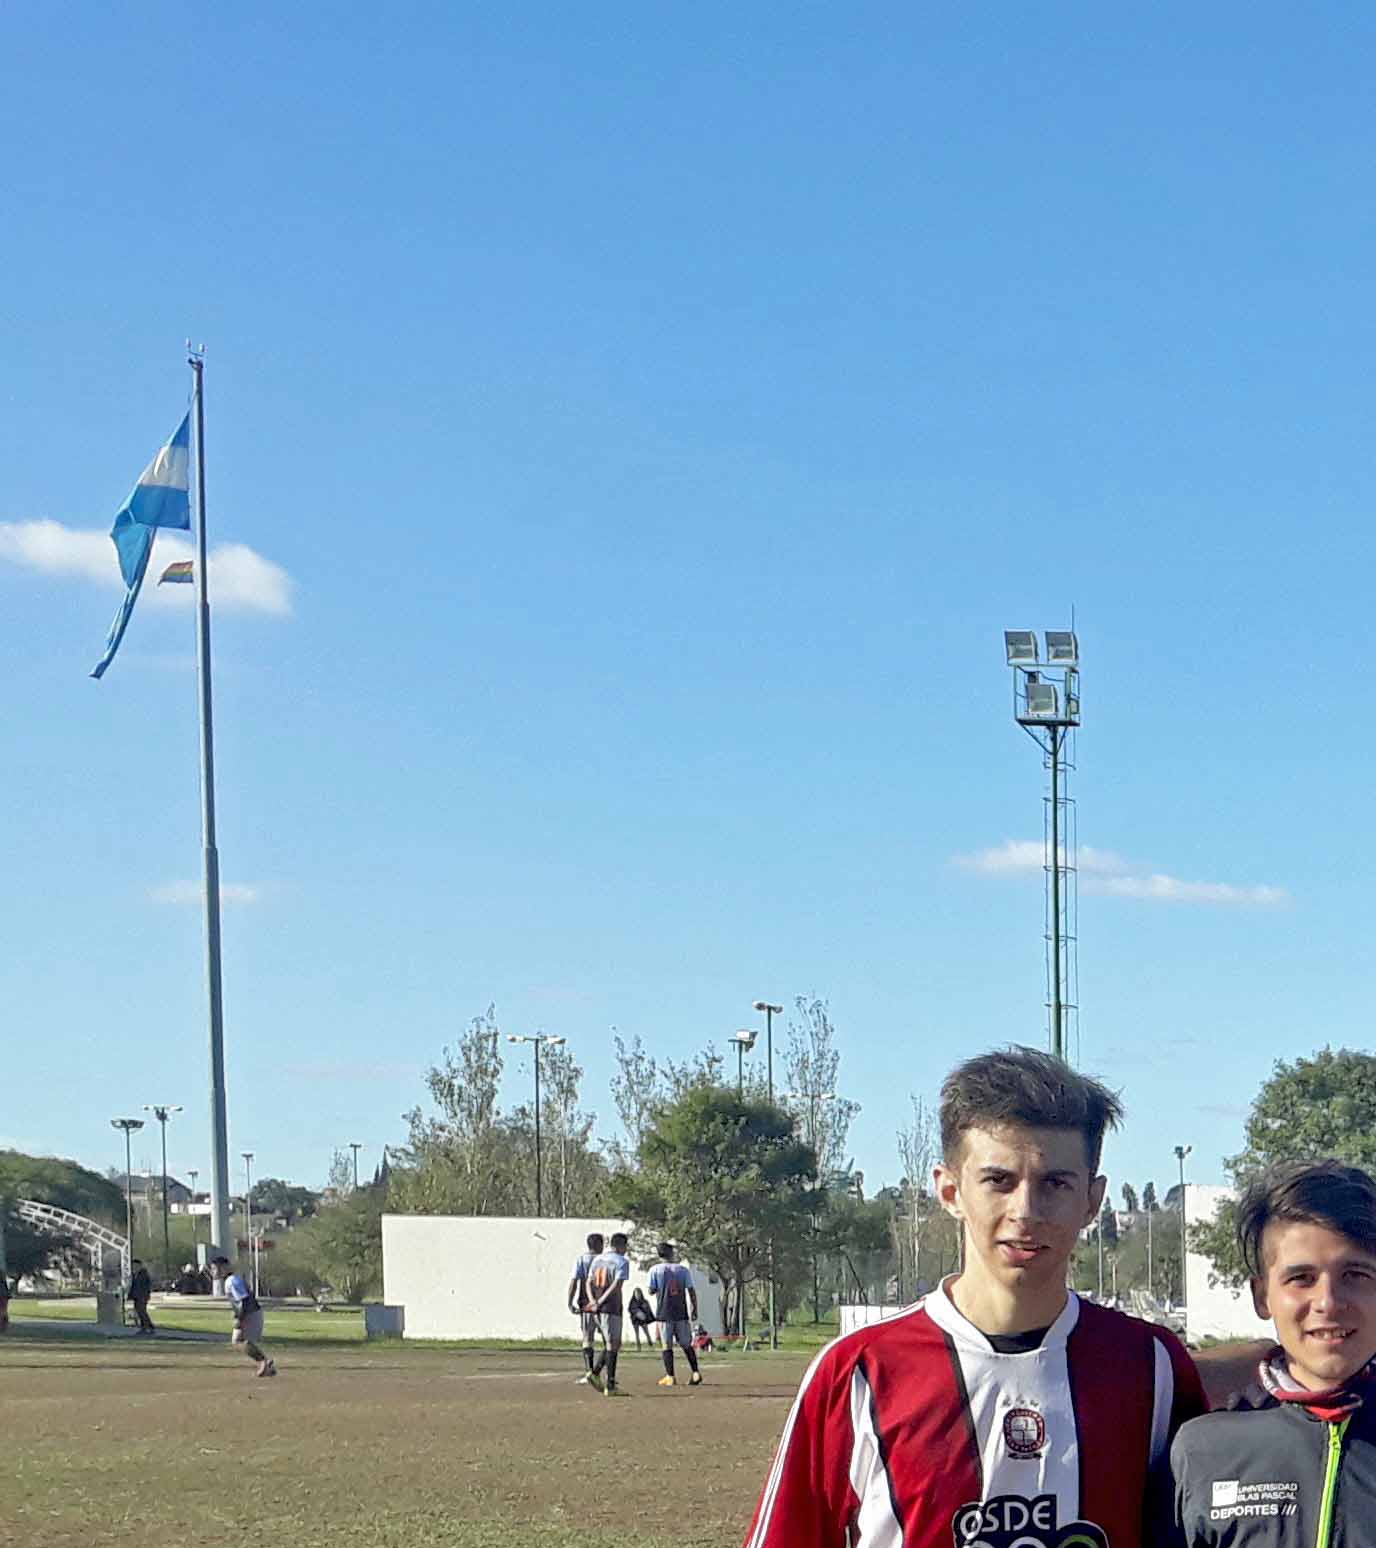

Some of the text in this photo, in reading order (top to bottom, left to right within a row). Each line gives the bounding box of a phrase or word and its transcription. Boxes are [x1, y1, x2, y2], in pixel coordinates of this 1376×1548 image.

[1239, 1483, 1298, 1493] UNIVERSIDAD
[1238, 1492, 1297, 1502] BLAS PASCAL
[1210, 1504, 1279, 1520] DEPORTES
[960, 1500, 1050, 1539] OSDE
